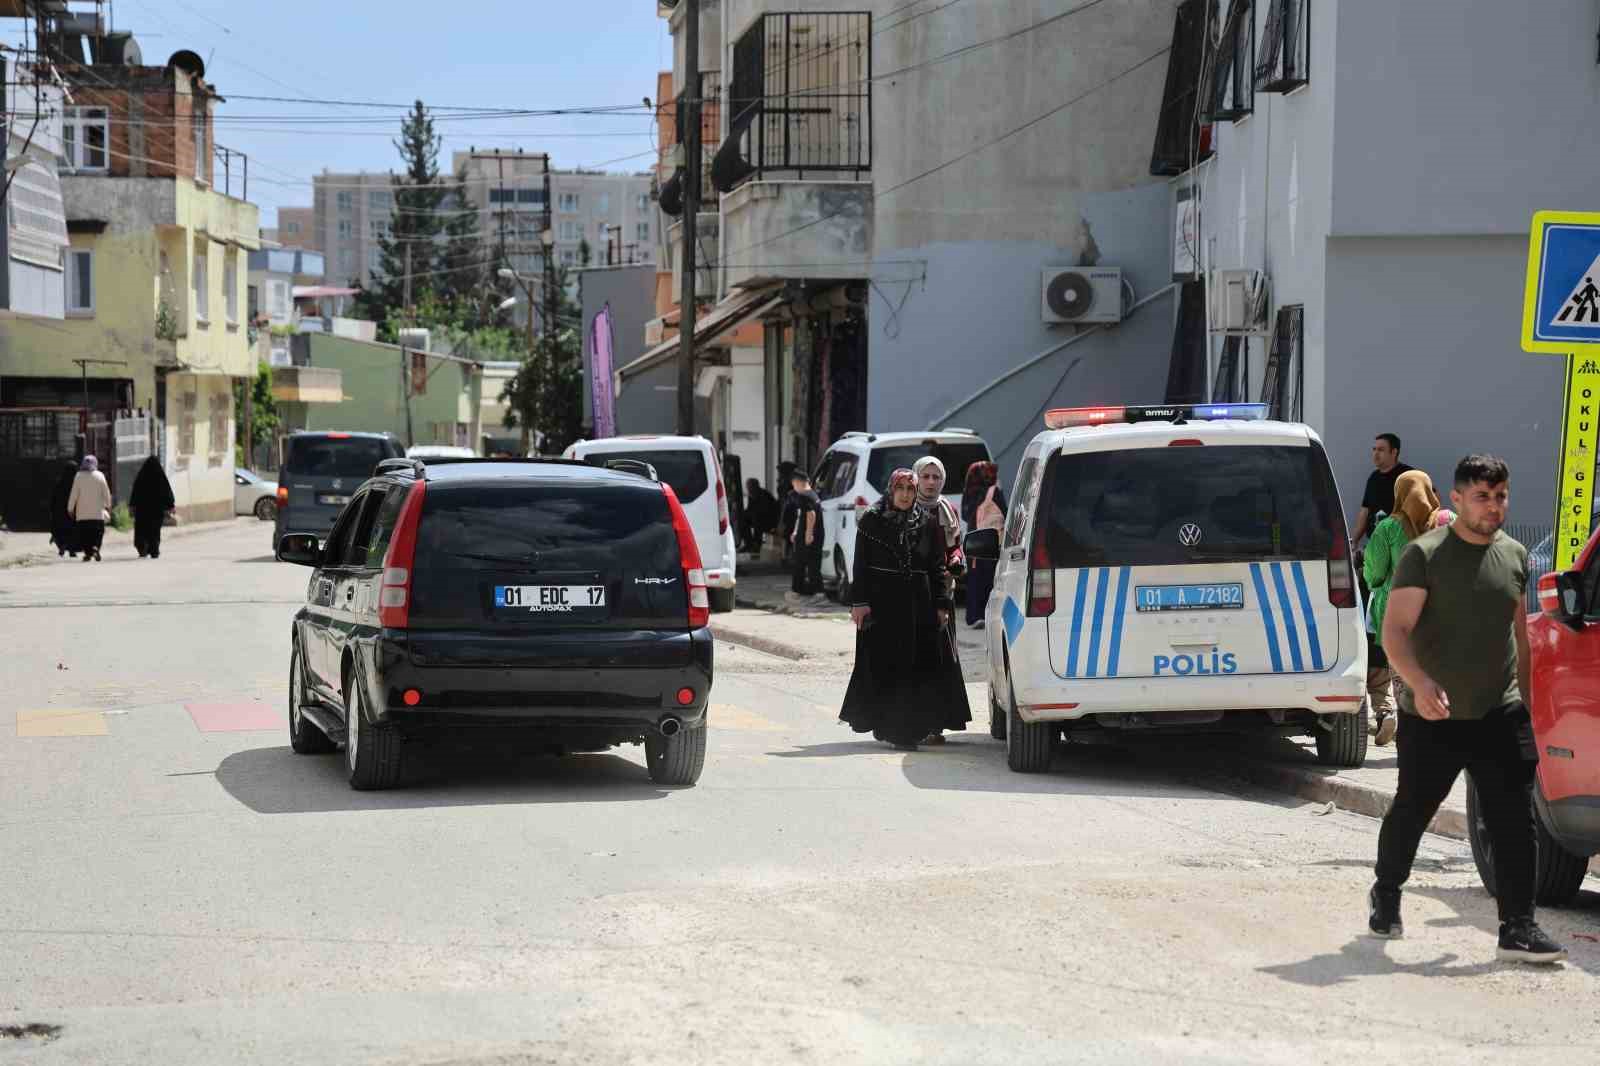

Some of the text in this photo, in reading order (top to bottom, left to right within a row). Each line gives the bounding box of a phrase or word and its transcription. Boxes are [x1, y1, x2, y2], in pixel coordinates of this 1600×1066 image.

[1579, 388, 1592, 448] OKUL
[504, 586, 604, 605] 01 EDC 17
[1146, 586, 1240, 605] 01 A 72182
[1153, 647, 1238, 675] POLİS
